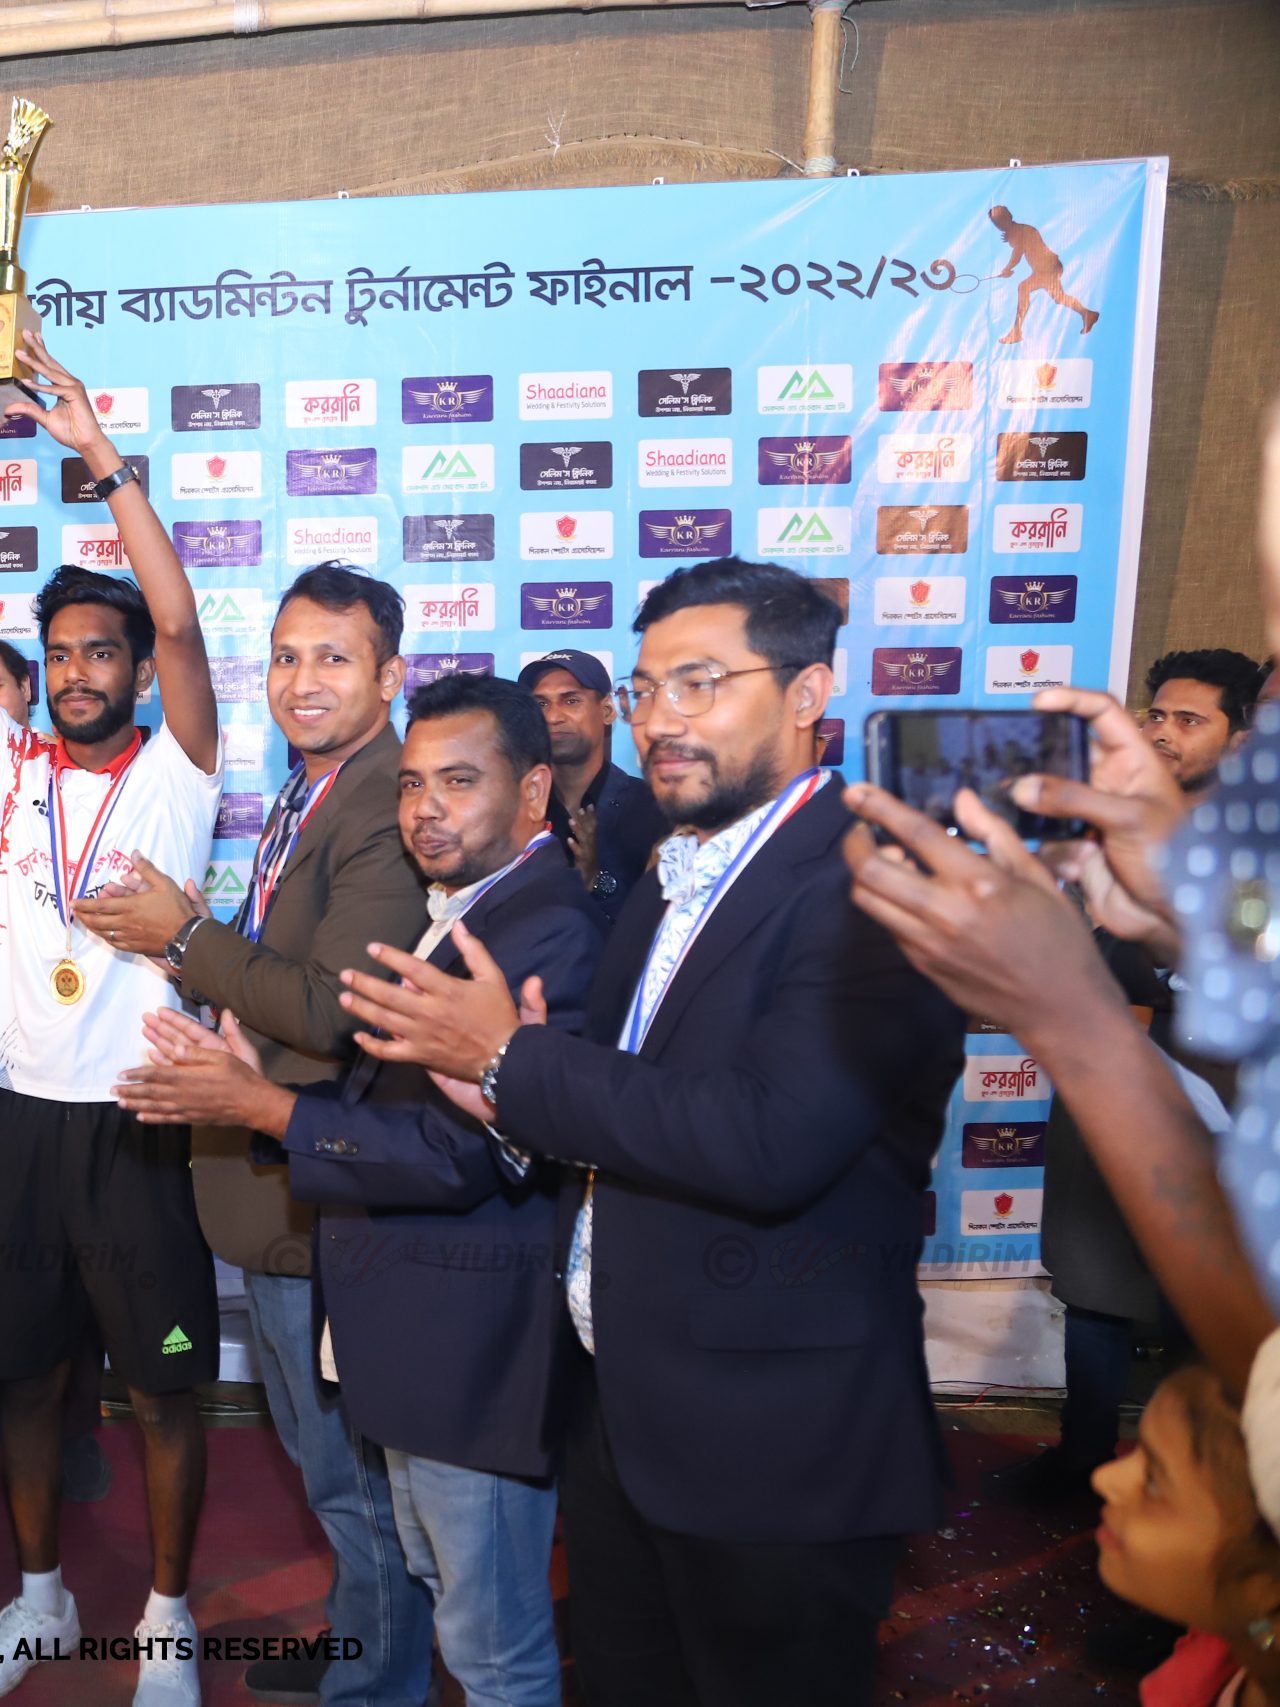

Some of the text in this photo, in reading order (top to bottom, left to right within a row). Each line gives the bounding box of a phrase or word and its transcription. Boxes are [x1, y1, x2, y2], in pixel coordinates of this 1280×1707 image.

[120, 269, 333, 324] ব্যাডমিন্টন
[345, 261, 514, 327] টুর্নামেন্ট
[527, 258, 693, 309] ফাইনাল
[526, 382, 606, 399] Shaadiana
[526, 402, 550, 410] Wedding
[557, 401, 580, 409] Festivity
[645, 449, 726, 466] Shaadiana
[646, 469, 670, 477] Wedding
[676, 468, 700, 476] Festivity
[293, 527, 371, 544] Shaadiana
[980, 1059, 1037, 1097] কররানি
[162, 1341, 192, 1355] adidas
